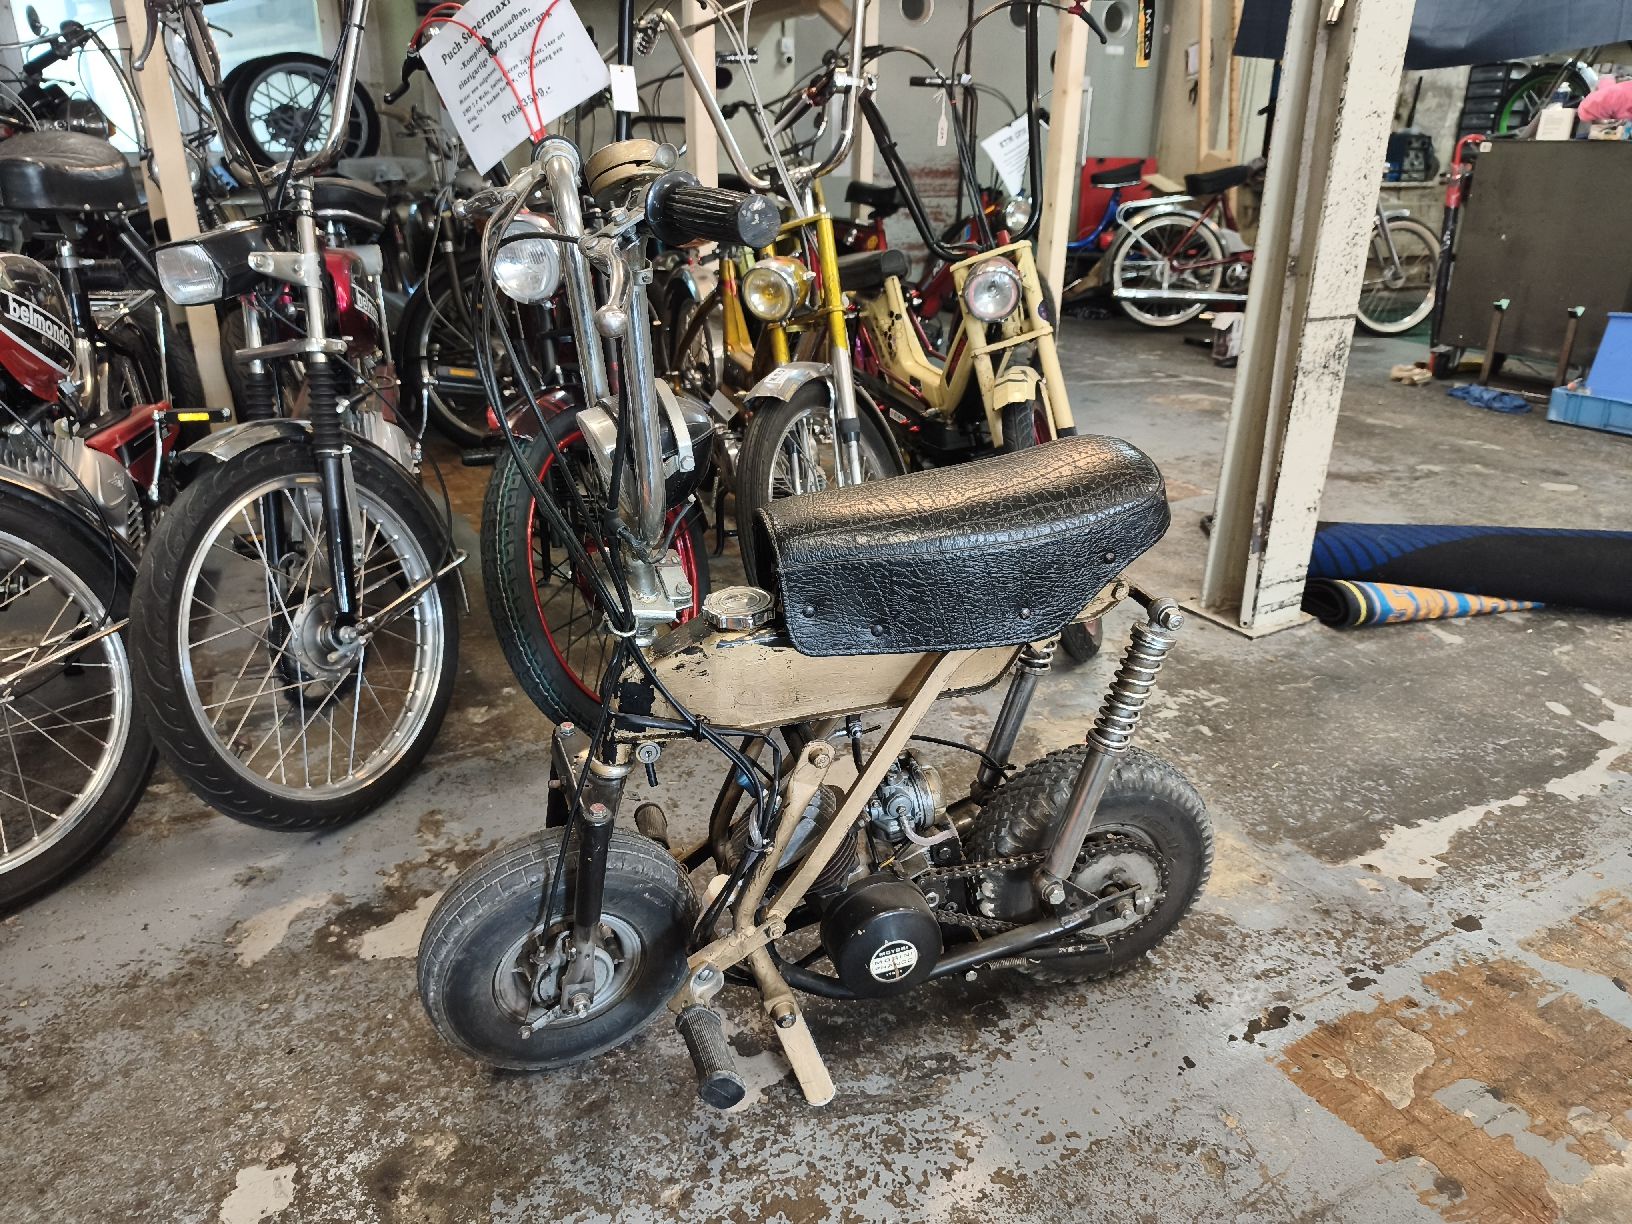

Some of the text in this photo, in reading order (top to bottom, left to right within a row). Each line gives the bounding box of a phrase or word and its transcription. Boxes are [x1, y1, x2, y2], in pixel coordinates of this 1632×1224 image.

[441, 0, 511, 65] Puch Supermaxi
[488, 39, 508, 59] Cndy
[501, 105, 522, 124] Preis
[8, 295, 71, 349] belmondo
